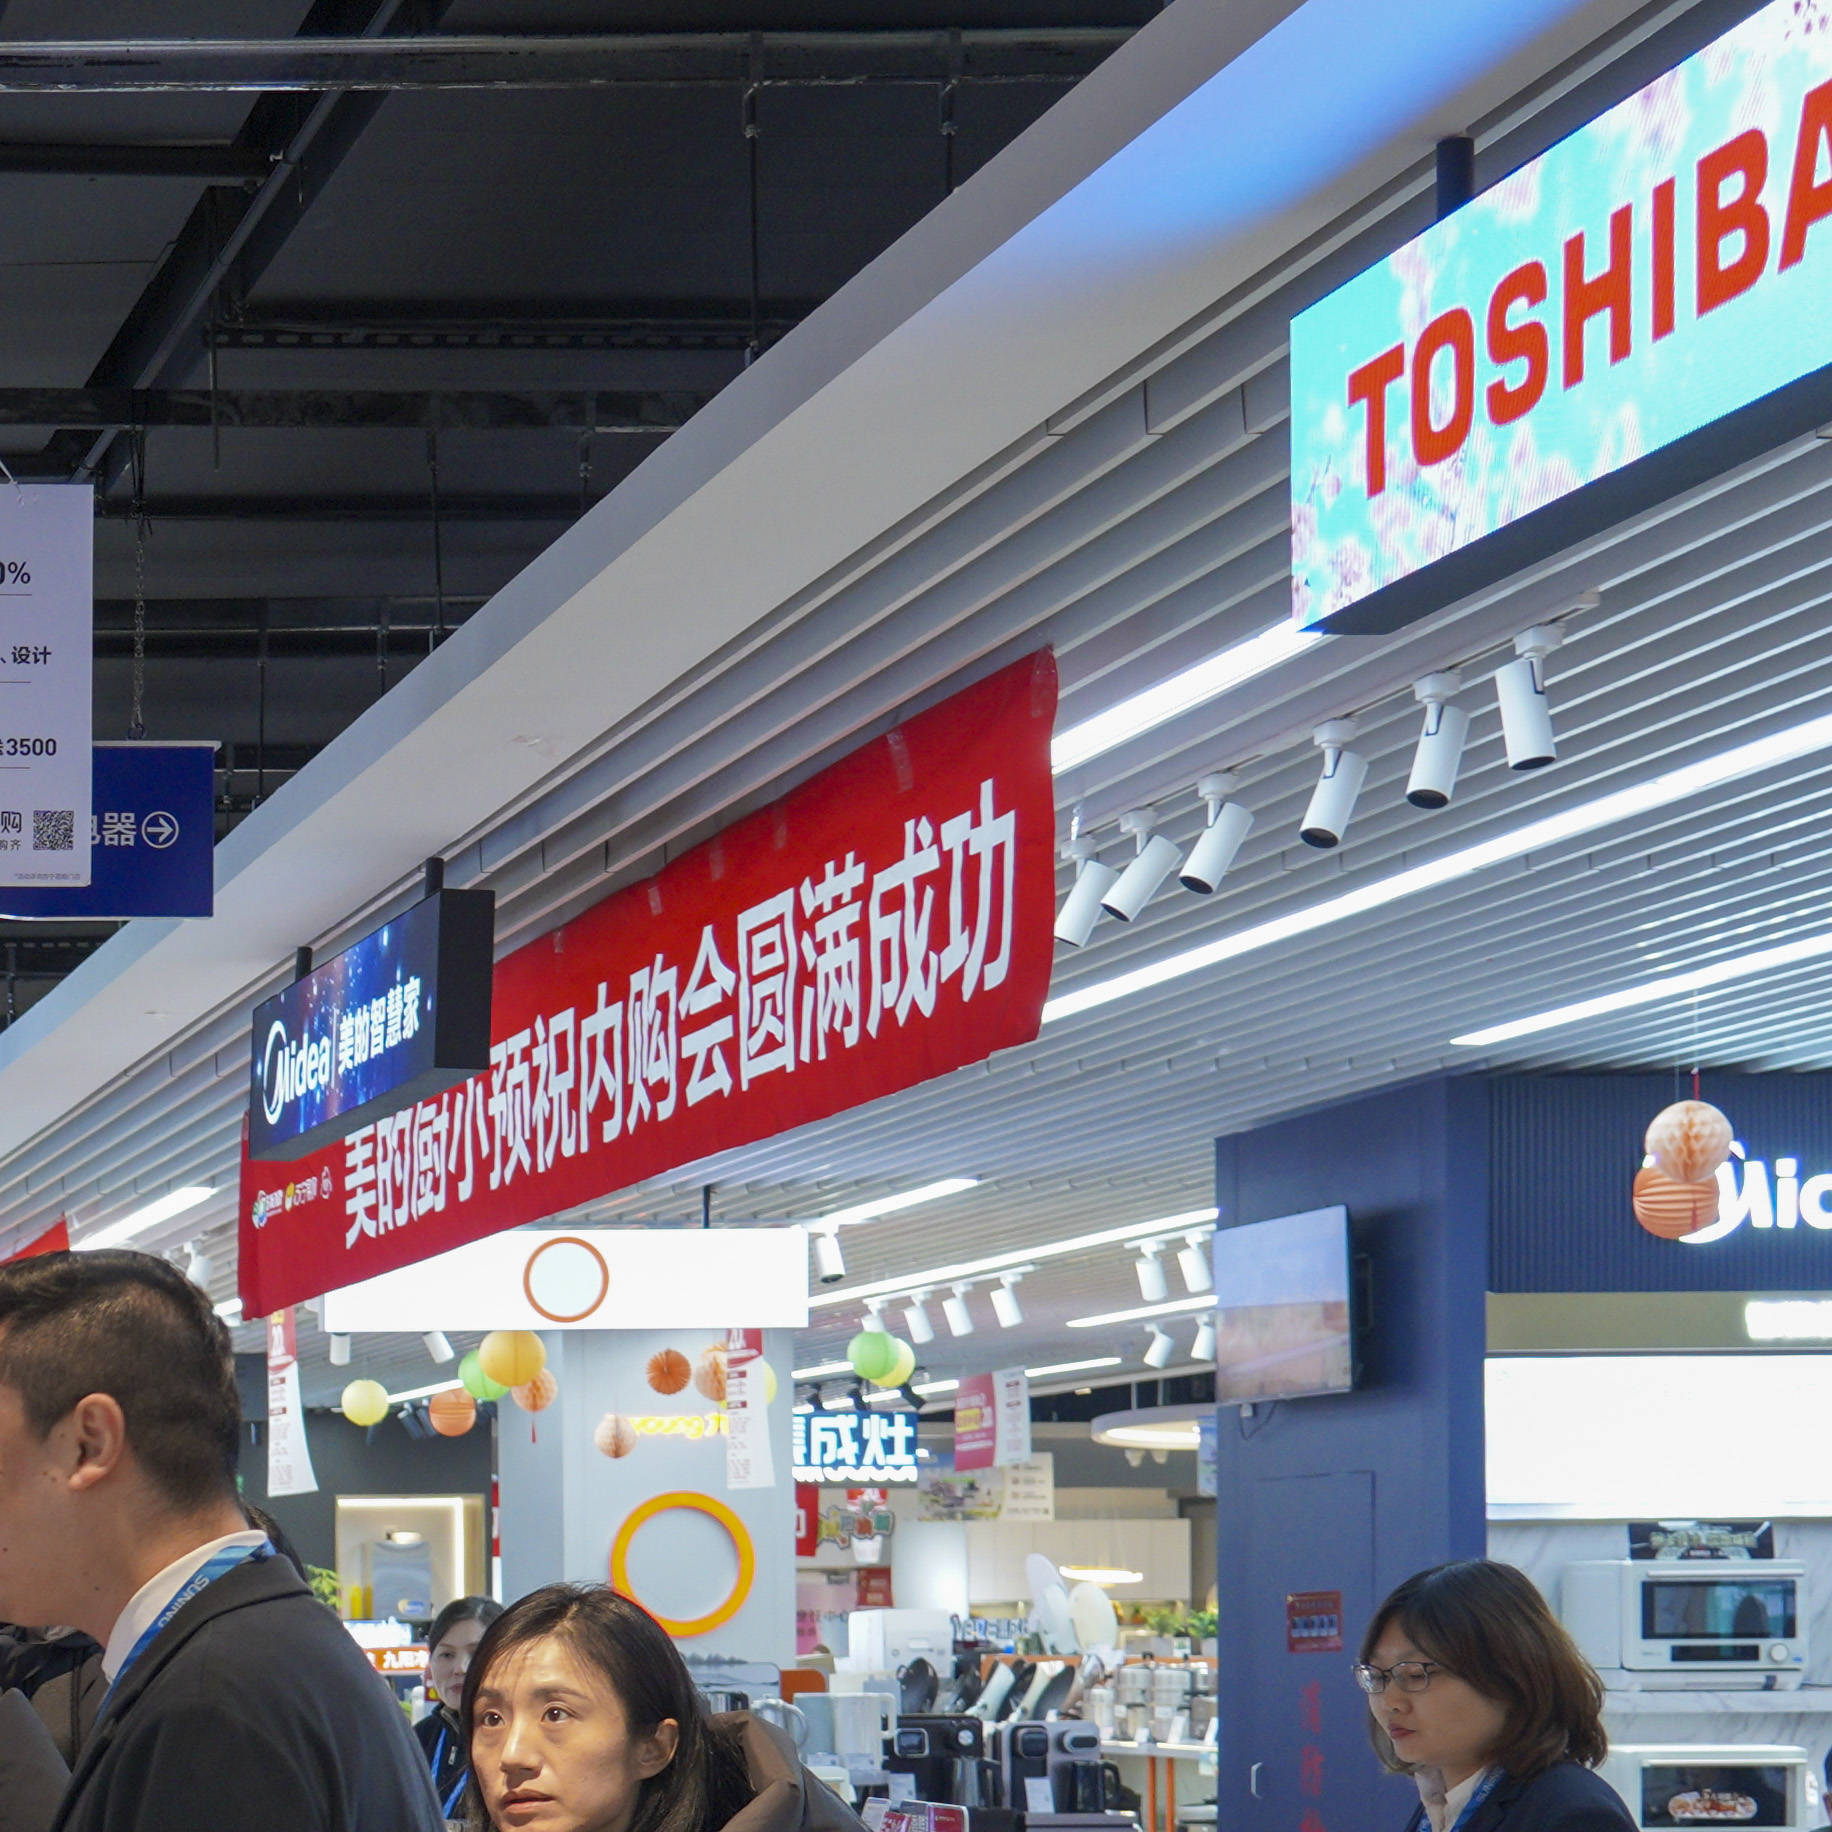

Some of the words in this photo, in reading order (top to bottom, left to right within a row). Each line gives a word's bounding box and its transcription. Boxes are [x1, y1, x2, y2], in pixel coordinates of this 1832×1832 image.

[91, 812, 137, 847] 器
[263, 1020, 333, 1126] Midea
[337, 975, 422, 1075] 美的智慧家
